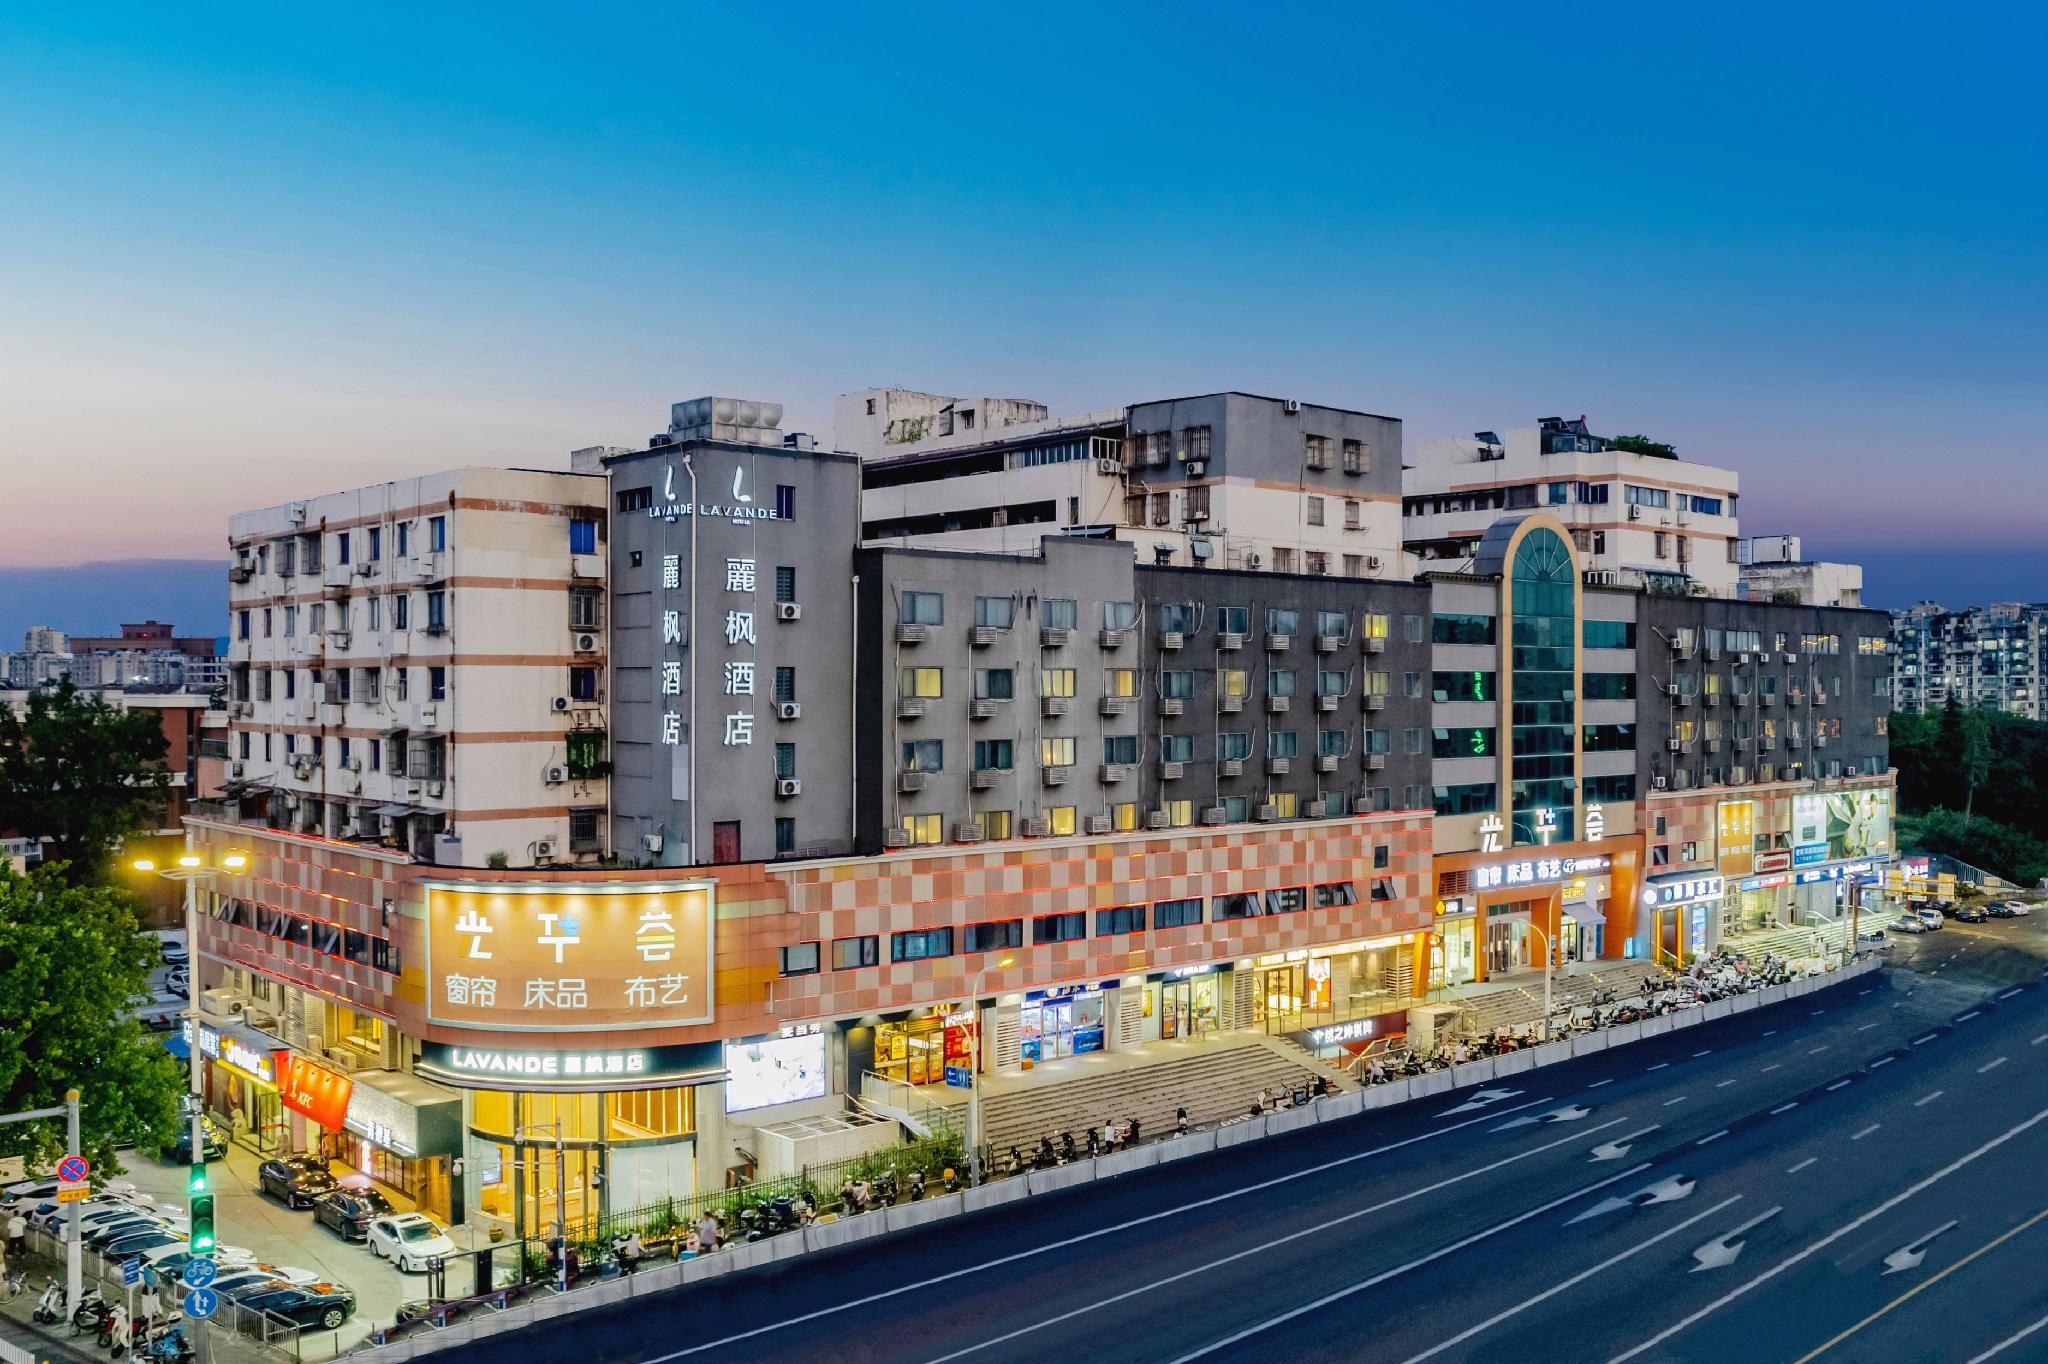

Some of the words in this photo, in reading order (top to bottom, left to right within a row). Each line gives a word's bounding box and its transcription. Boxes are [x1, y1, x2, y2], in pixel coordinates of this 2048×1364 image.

[649, 503, 692, 517] LAVANDE
[700, 504, 777, 519] LAVANDE
[724, 558, 756, 746] 麗枫酒店
[445, 973, 496, 1008] 窗帘
[523, 977, 588, 1009] 床品
[623, 973, 689, 1008] 布艺
[781, 1022, 821, 1038] 麦当劳
[452, 1049, 557, 1073] LAVANDE
[297, 1091, 313, 1109] KFC
